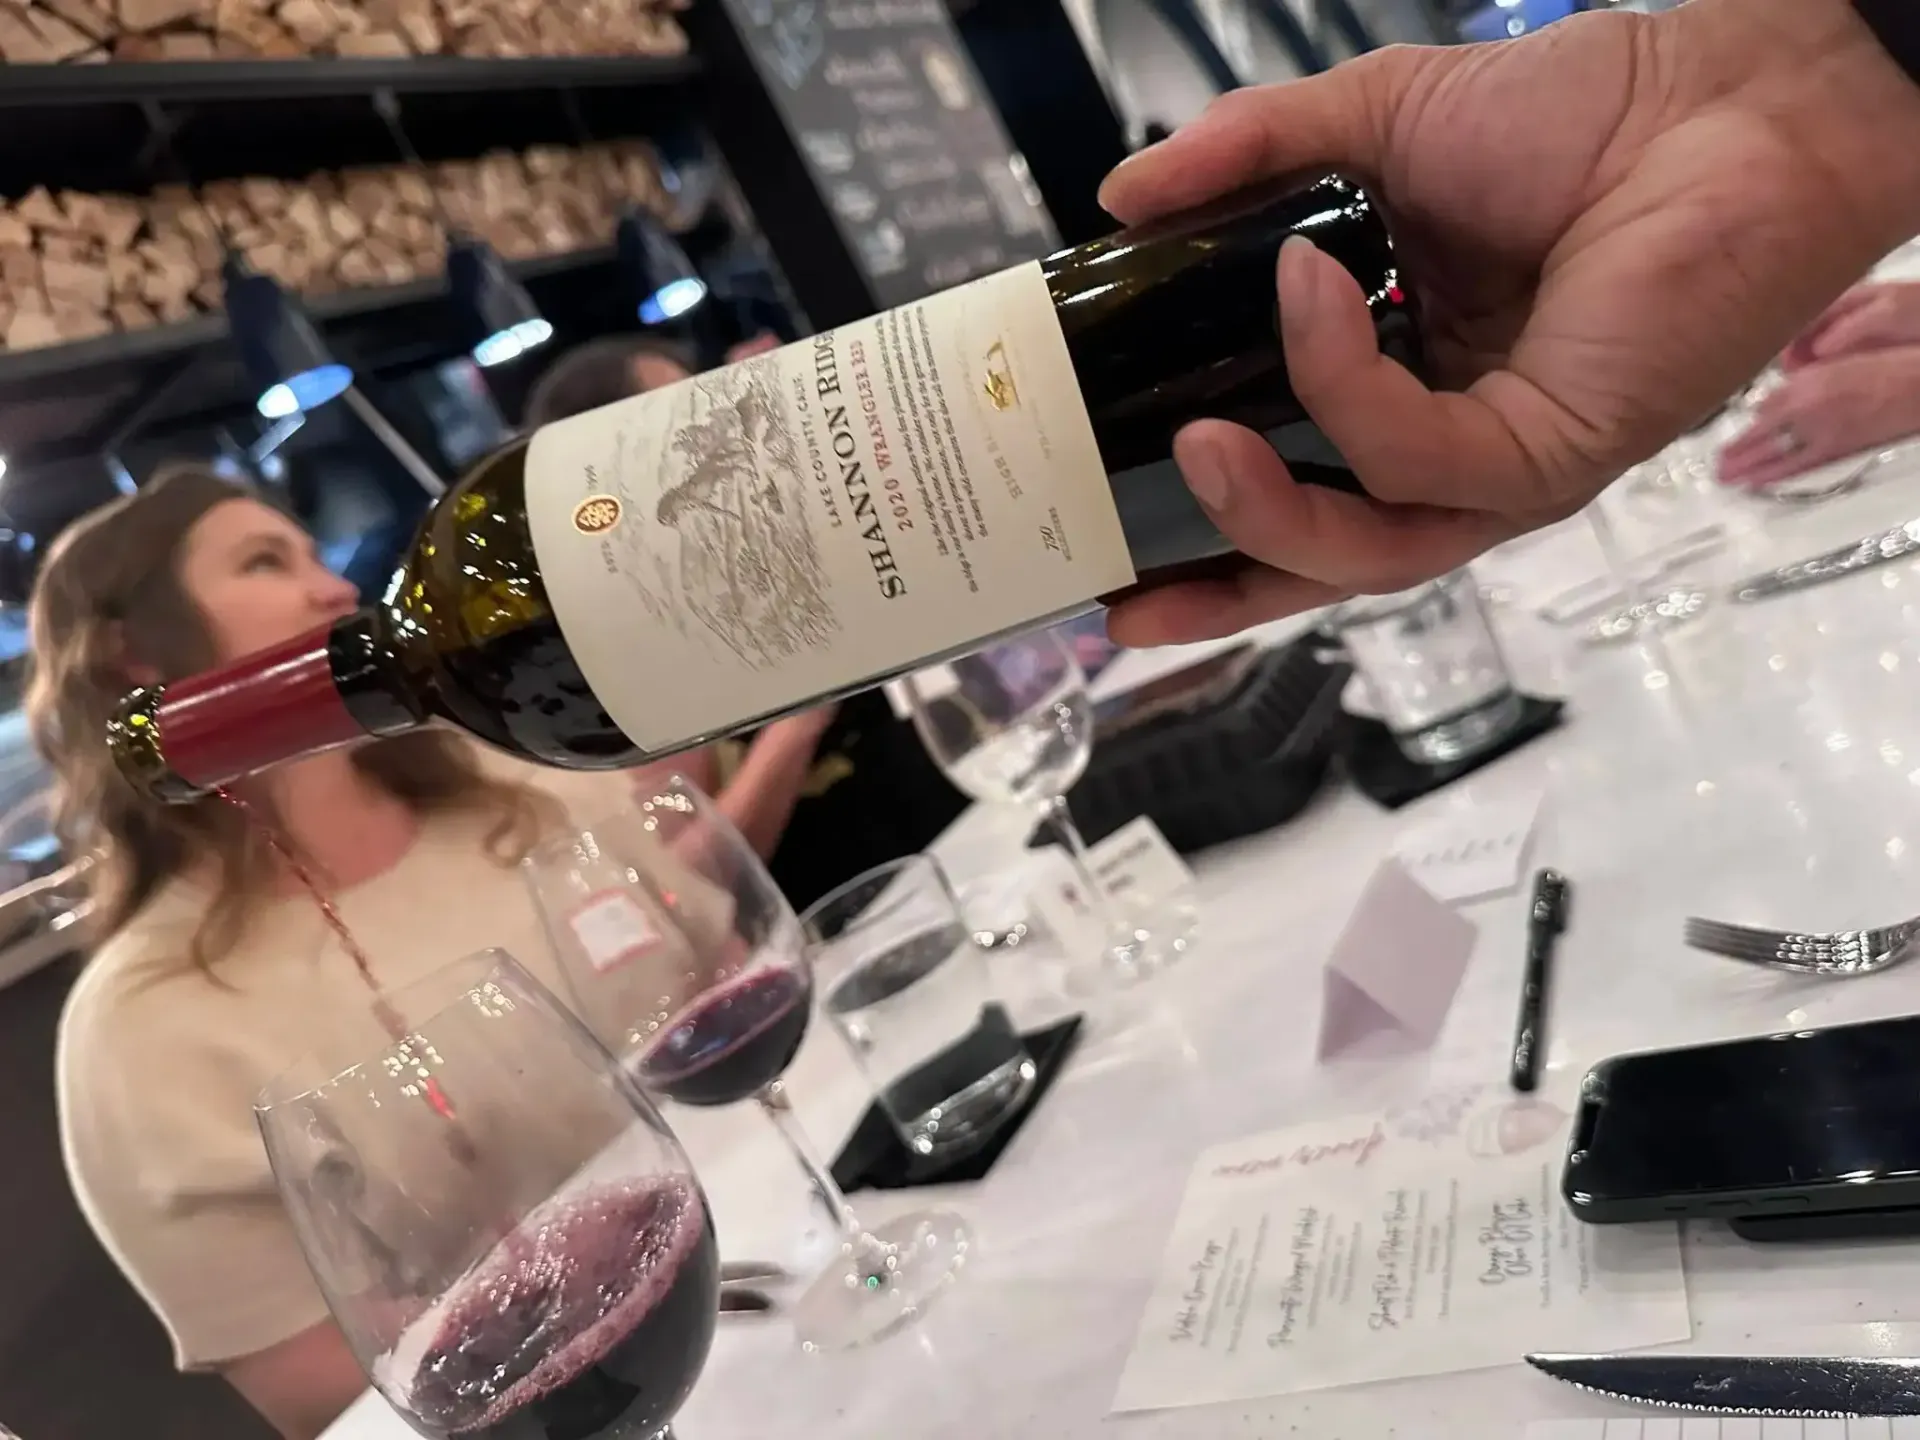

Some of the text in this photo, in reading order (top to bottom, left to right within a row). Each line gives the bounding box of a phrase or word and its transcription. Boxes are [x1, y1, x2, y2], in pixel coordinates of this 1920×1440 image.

[798, 413, 827, 483] COUNTY,
[852, 366, 893, 471] WRANGLER
[810, 330, 907, 601] SHANNON RIDG
[818, 485, 842, 528] LAKE
[882, 476, 914, 532] 2020
